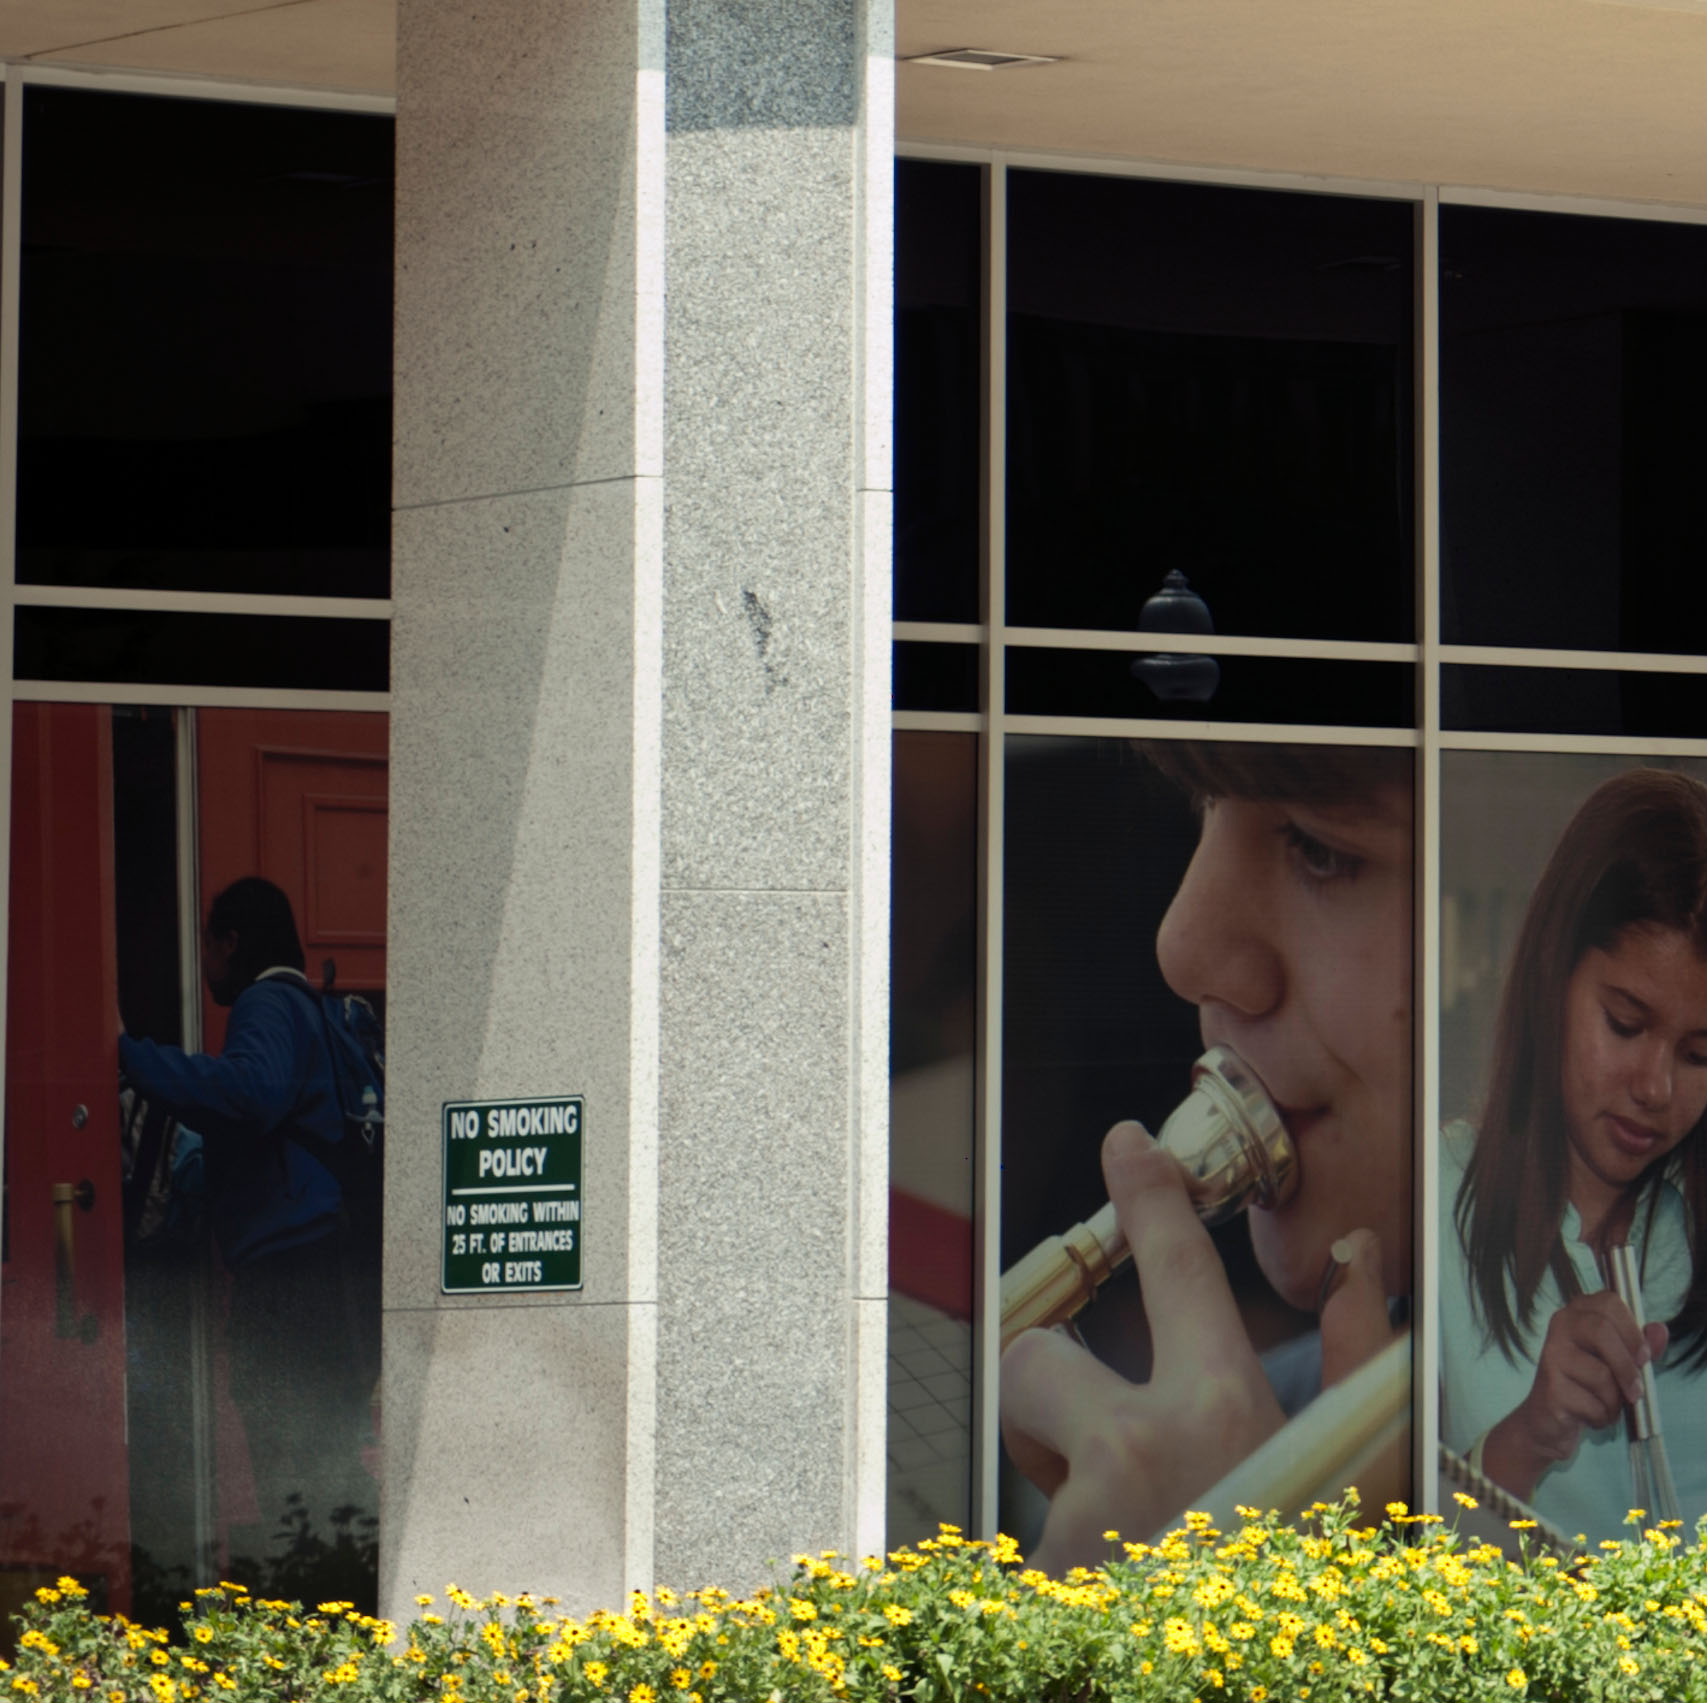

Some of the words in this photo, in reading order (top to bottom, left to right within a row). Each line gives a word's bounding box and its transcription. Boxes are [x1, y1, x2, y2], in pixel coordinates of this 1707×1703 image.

[451, 1111, 480, 1139] NO
[488, 1105, 577, 1138] SMOKING
[479, 1147, 547, 1178] POLICY
[447, 1205, 466, 1226] NO
[470, 1202, 528, 1225] SMOKING
[533, 1200, 579, 1223] WITHIN
[452, 1234, 466, 1255] 25
[469, 1233, 487, 1254] FT.
[490, 1232, 505, 1253] OF
[508, 1230, 573, 1253] ENTRANCES
[482, 1262, 500, 1284] OR
[505, 1261, 542, 1283] EXITS
